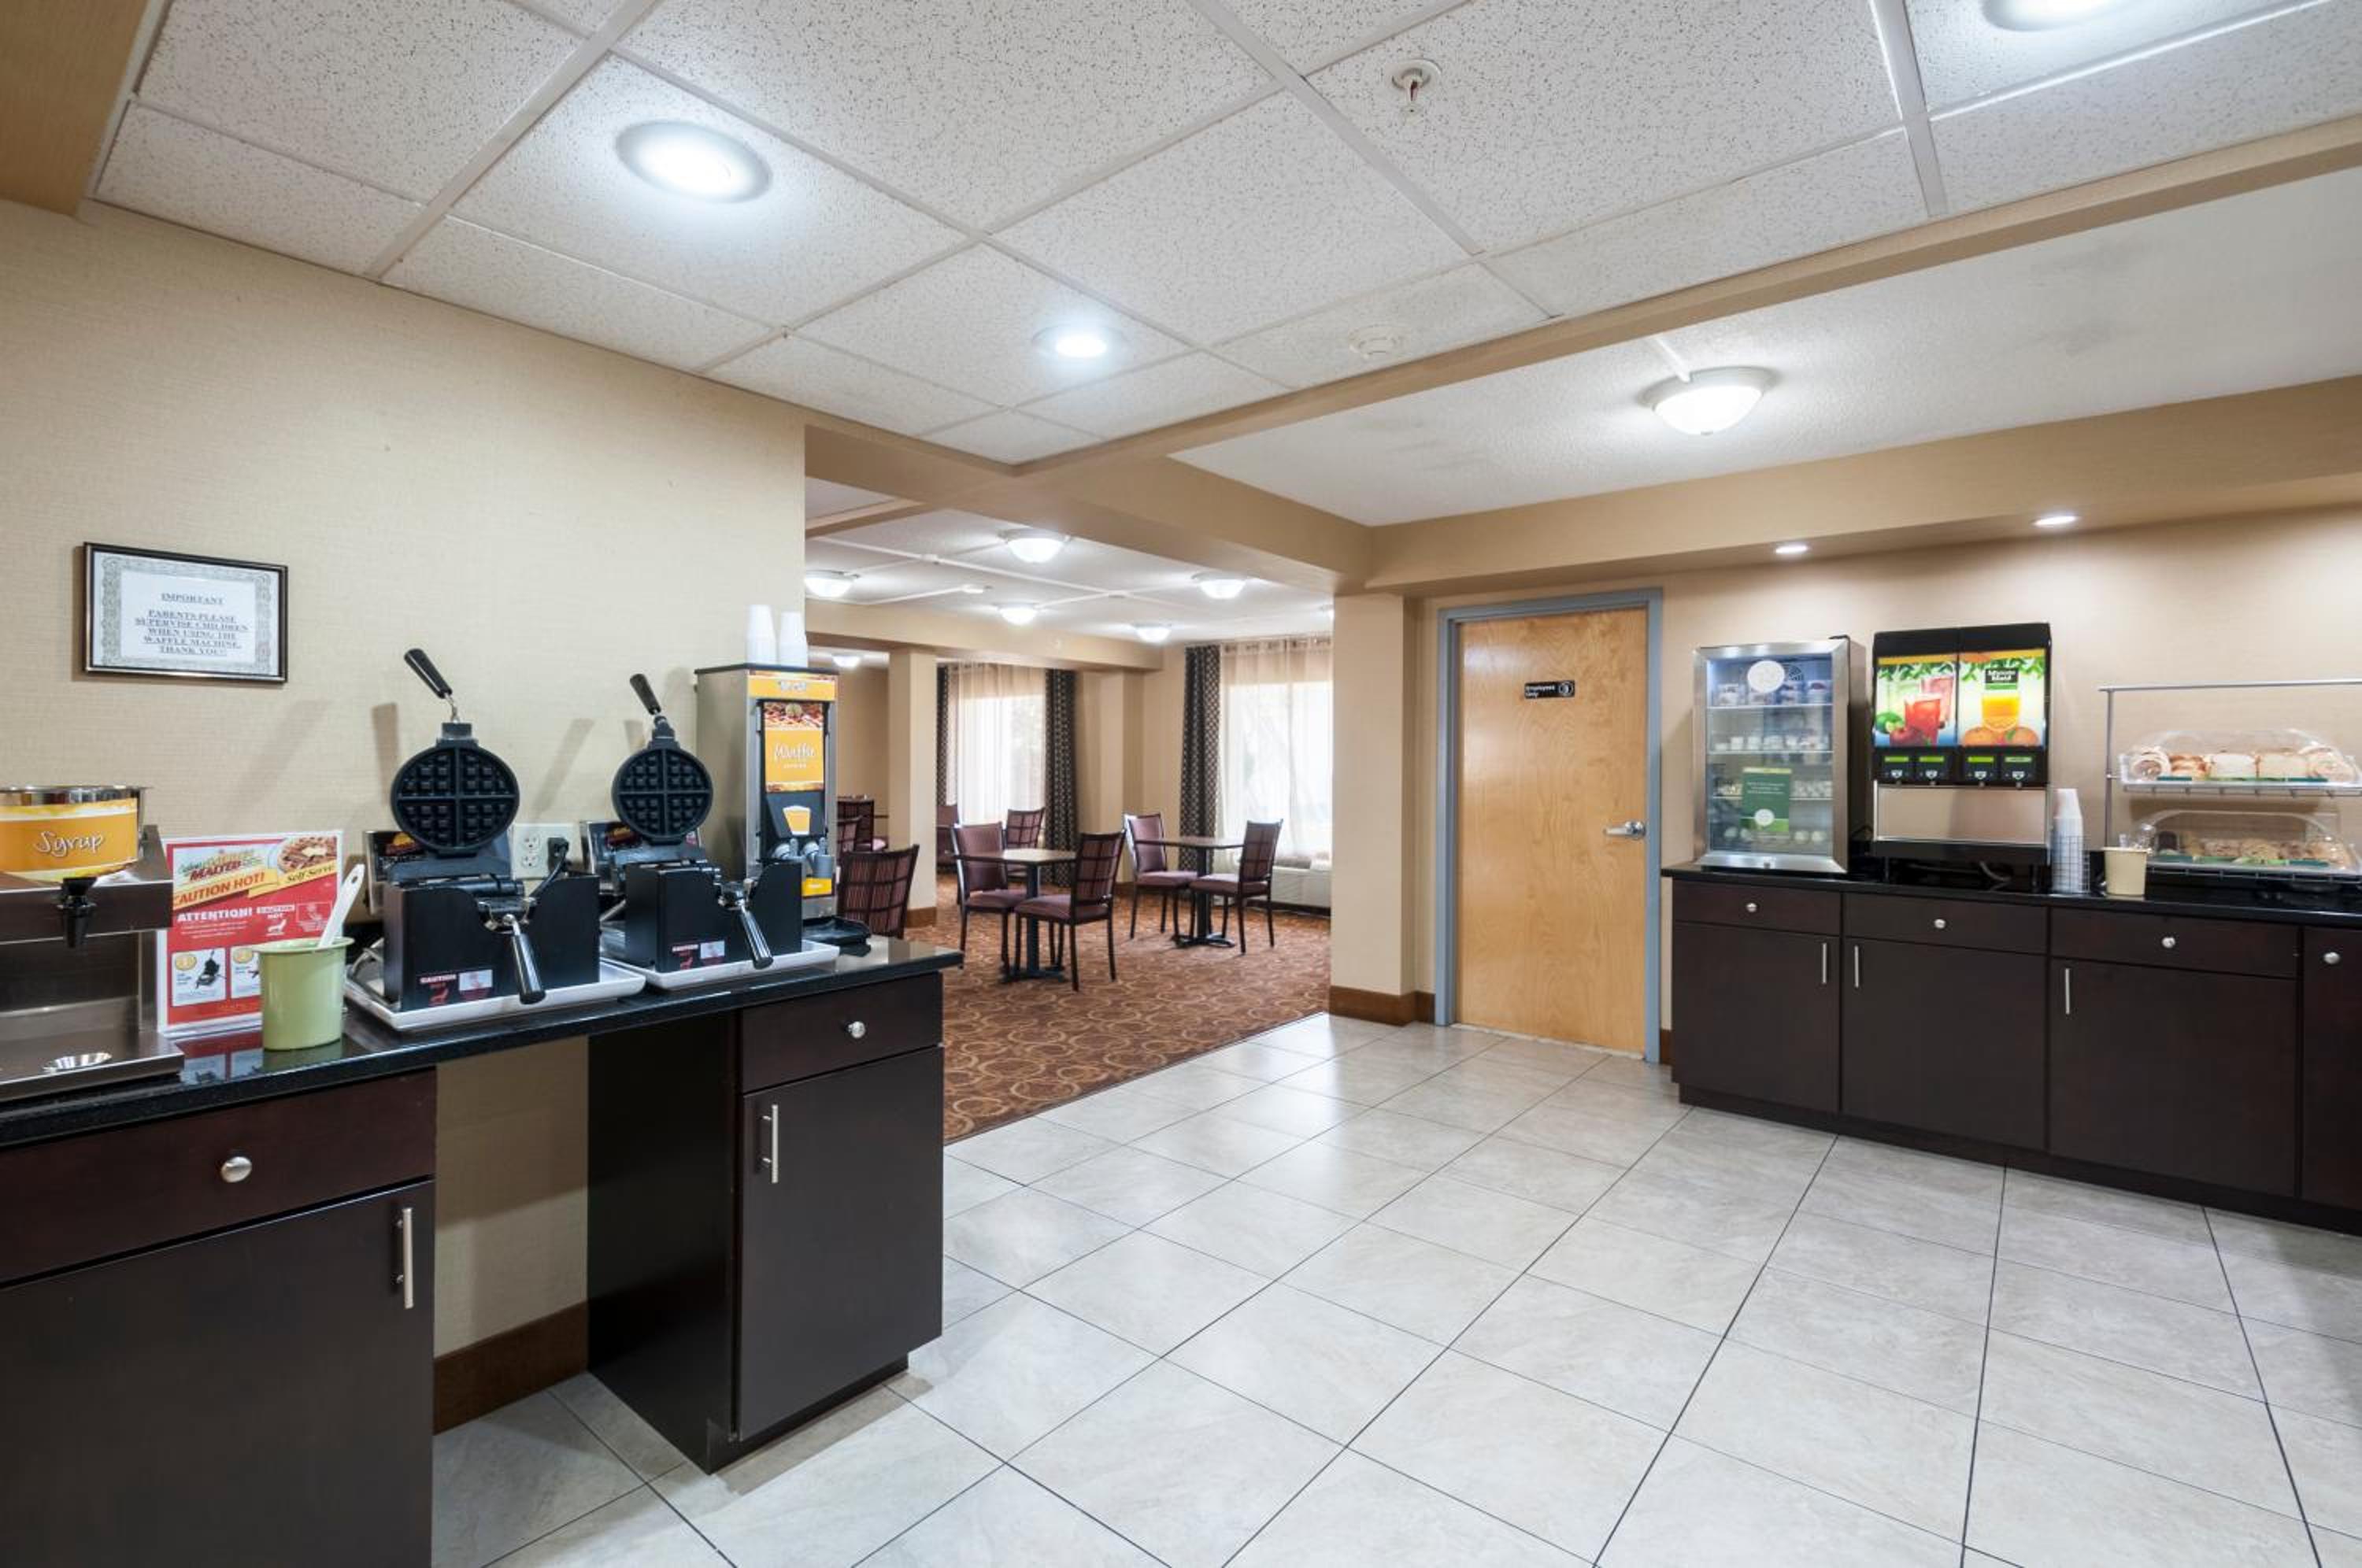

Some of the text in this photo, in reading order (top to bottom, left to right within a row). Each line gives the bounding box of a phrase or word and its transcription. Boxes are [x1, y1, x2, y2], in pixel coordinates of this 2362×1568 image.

[161, 593, 224, 605] IMPORTANT
[34, 831, 105, 857] Syrup
[235, 871, 265, 888] HOT!
[177, 908, 252, 922] ATTENTION!
